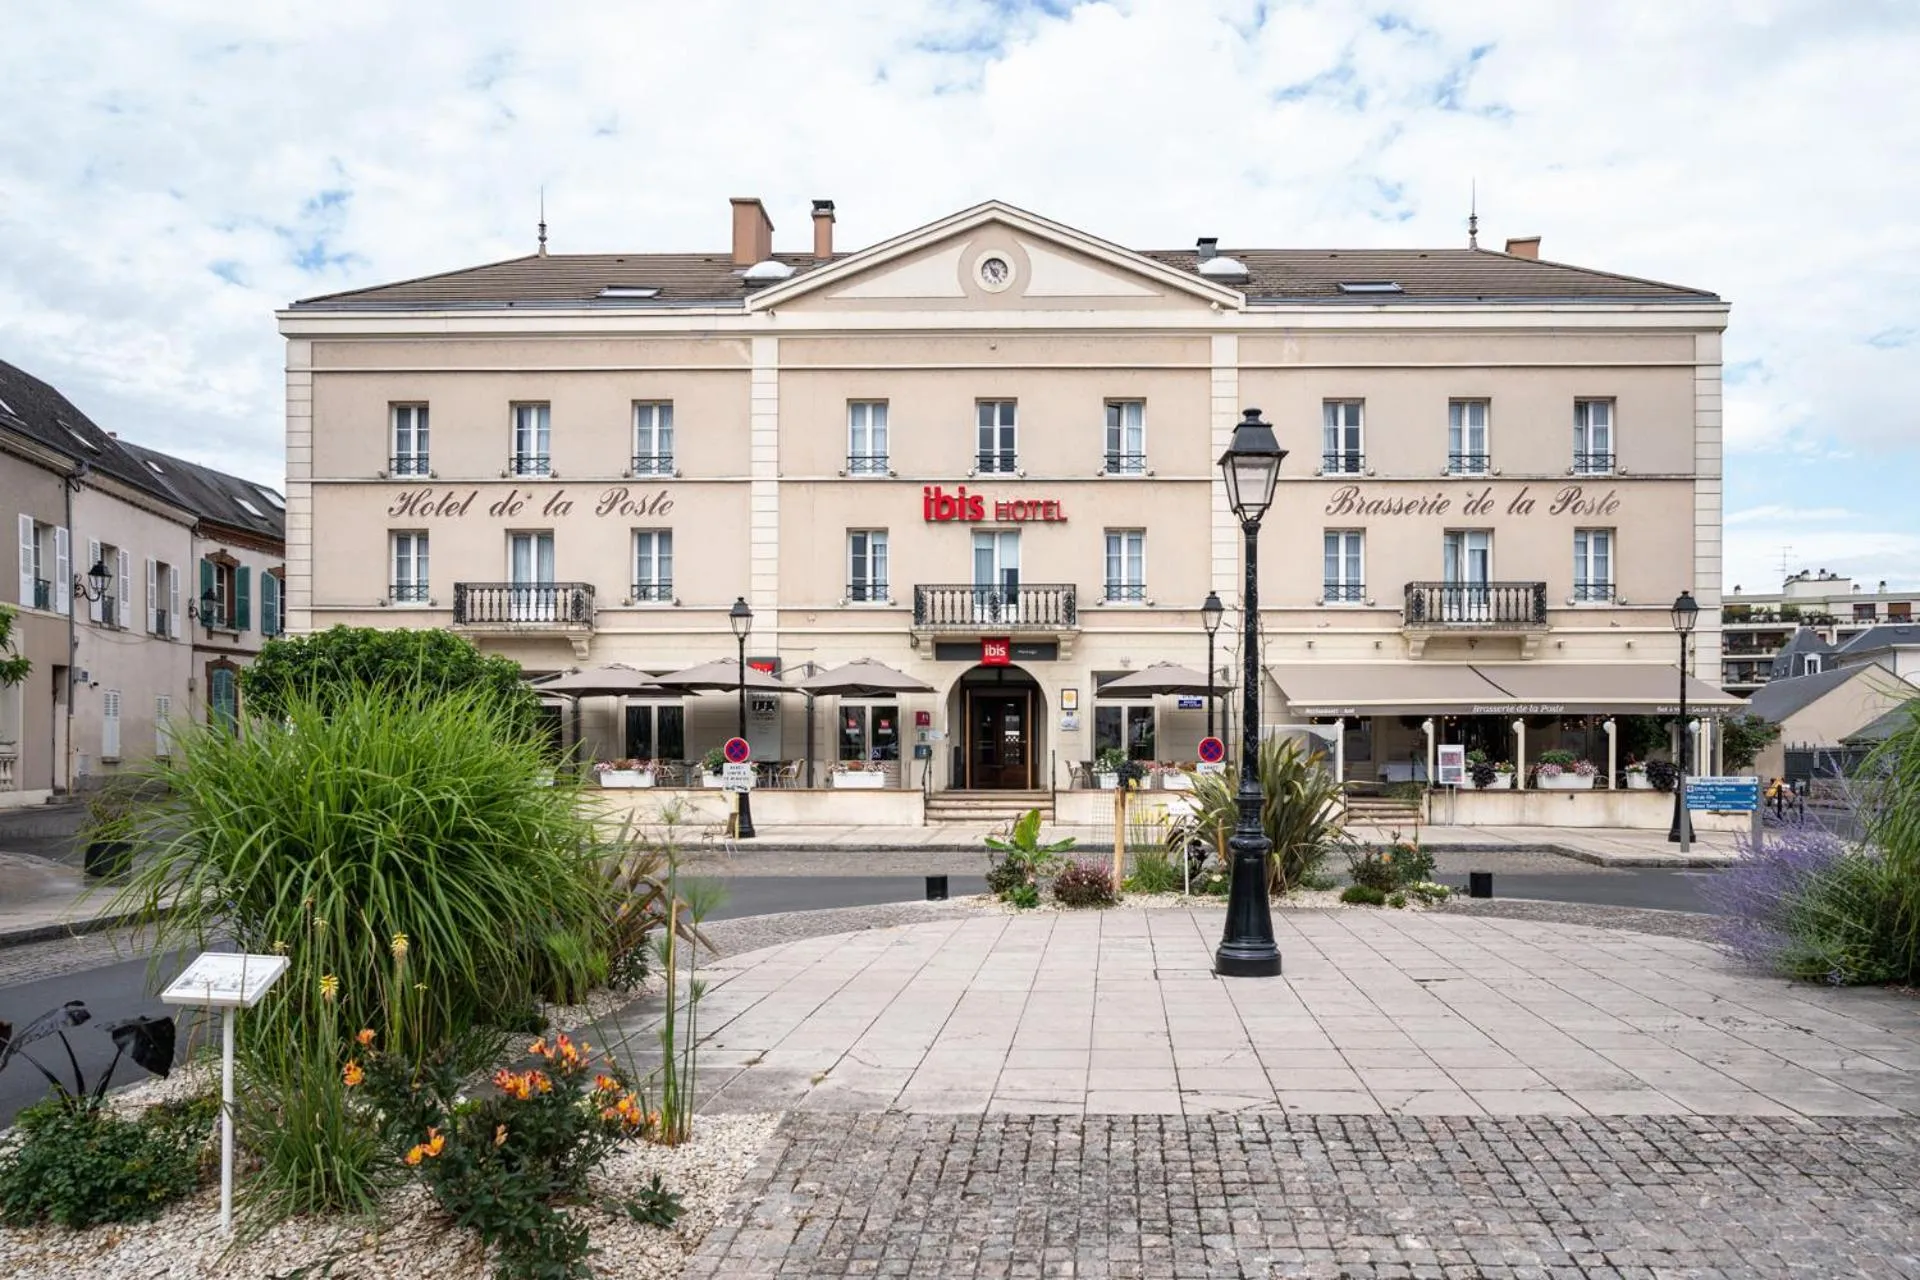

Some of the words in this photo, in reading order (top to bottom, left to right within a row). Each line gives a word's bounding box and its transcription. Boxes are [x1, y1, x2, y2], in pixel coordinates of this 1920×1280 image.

[388, 487, 479, 517] Hotel
[489, 488, 523, 517] de
[543, 489, 574, 517] la
[595, 486, 675, 517] Poste
[923, 486, 985, 521] ibis
[995, 500, 1068, 523] HOTEL
[1325, 484, 1450, 516] Brasserie
[1463, 486, 1495, 516] de
[1507, 486, 1536, 516] la
[1550, 485, 1621, 516] Poste
[984, 644, 1007, 657] ibis
[1472, 704, 1515, 714] Brasserie
[1516, 704, 1528, 713] de
[1529, 704, 1539, 713] la
[1540, 704, 1565, 713] Poste
